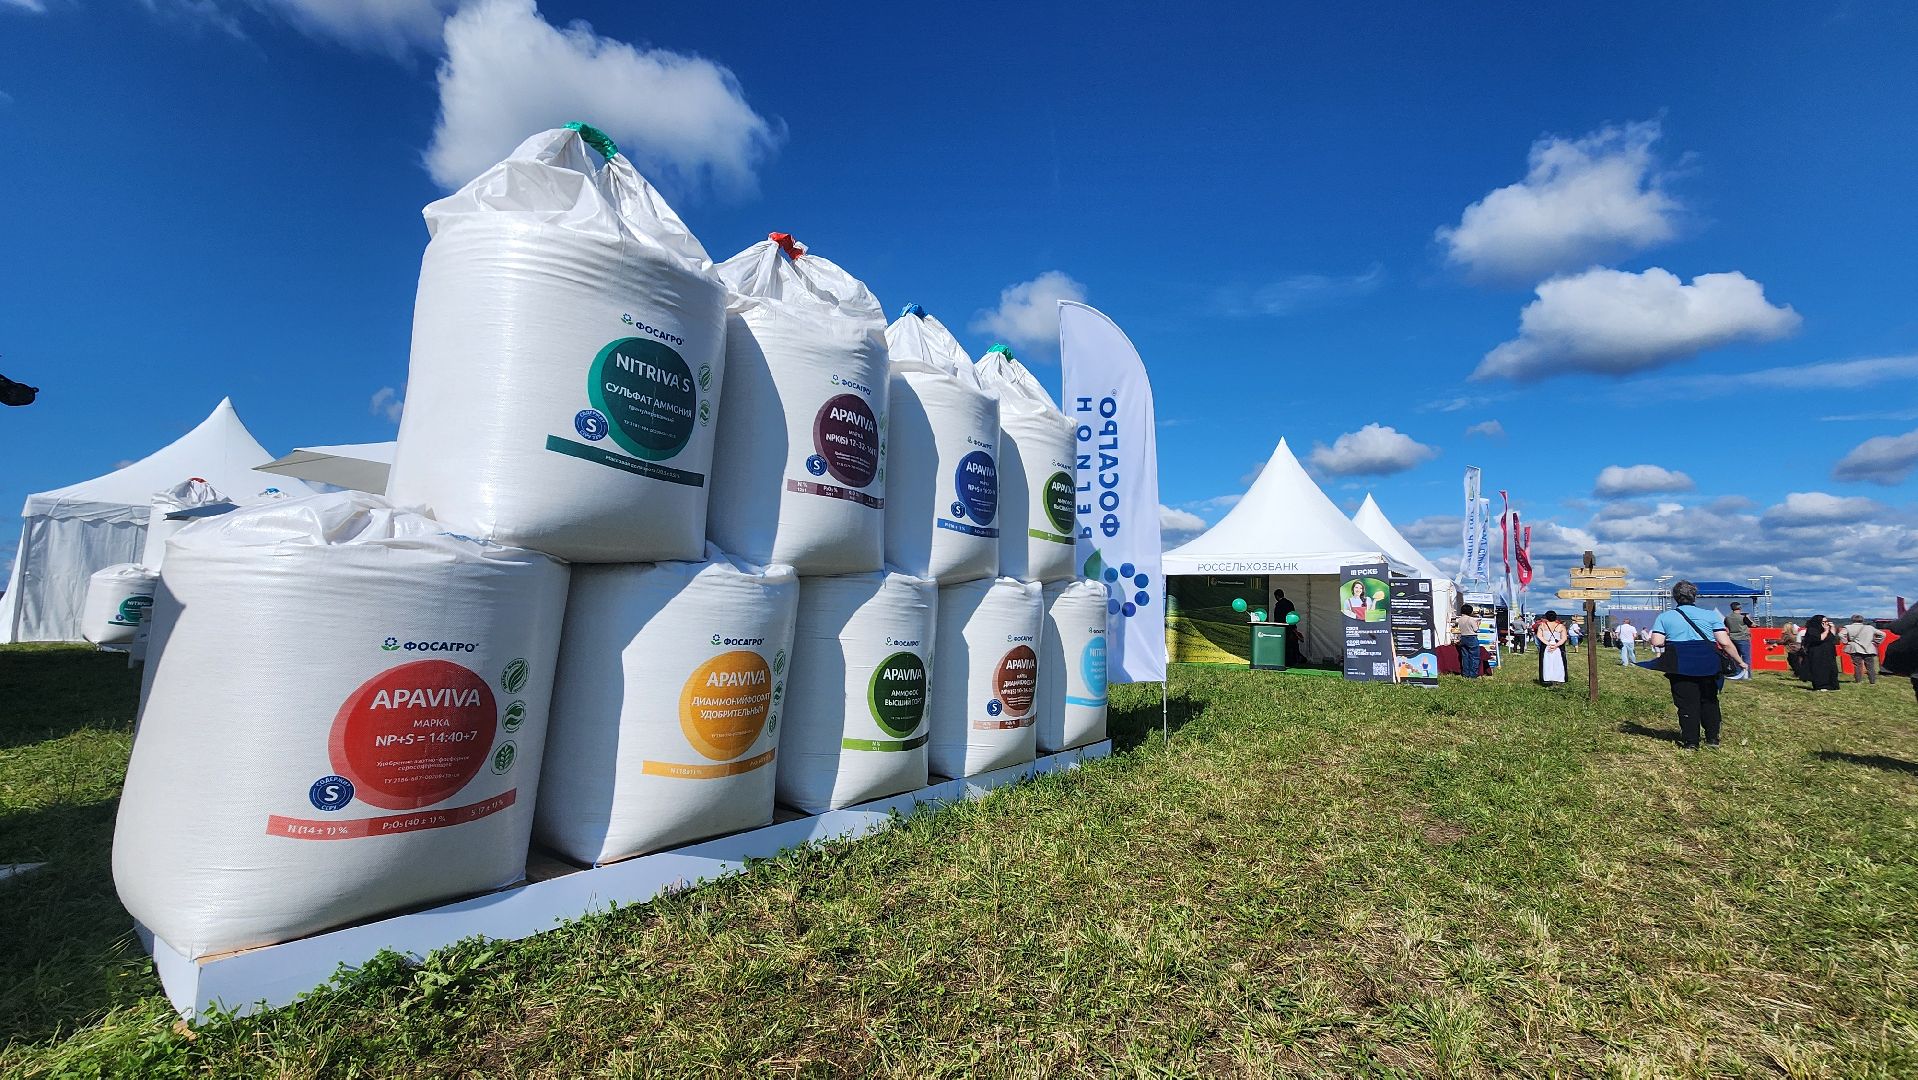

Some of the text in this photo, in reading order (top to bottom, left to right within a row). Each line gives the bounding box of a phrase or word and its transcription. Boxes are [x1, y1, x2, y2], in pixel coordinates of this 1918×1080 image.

[635, 321, 684, 346] ФОСАГРО
[616, 352, 679, 391] NITRIVA
[841, 379, 871, 396] ФОСАГРО
[605, 382, 692, 419] СУЛЬФАТ АММОНИЯ
[585, 418, 597, 433] S
[829, 406, 875, 434] APAVIVA
[825, 433, 849, 446] NPK(S)
[813, 460, 820, 470] S
[966, 461, 995, 477] APAVIVA
[956, 505, 961, 514] S
[1197, 562, 1299, 572] РОССЕЛЬХОЗБАНК
[403, 641, 477, 653] ФОСАГРО
[723, 637, 763, 646] ФОСАГРО
[1006, 658, 1036, 670] APAVIVA
[706, 670, 766, 687] APAVIVA
[882, 667, 923, 681] APAVIVA
[369, 688, 481, 710] APAVIVA
[691, 691, 771, 707] ДИАММОНИЙФОСФАТ
[884, 697, 911, 706] ВЫСШИЙ
[700, 703, 764, 720] УДОБРИТЕЛЬНЫЙ
[992, 703, 997, 711] S
[413, 718, 450, 728] МАРКА
[375, 734, 415, 747] NP+S
[429, 730, 478, 744] 14:40+7
[324, 785, 339, 802] S
[338, 826, 348, 834] %
